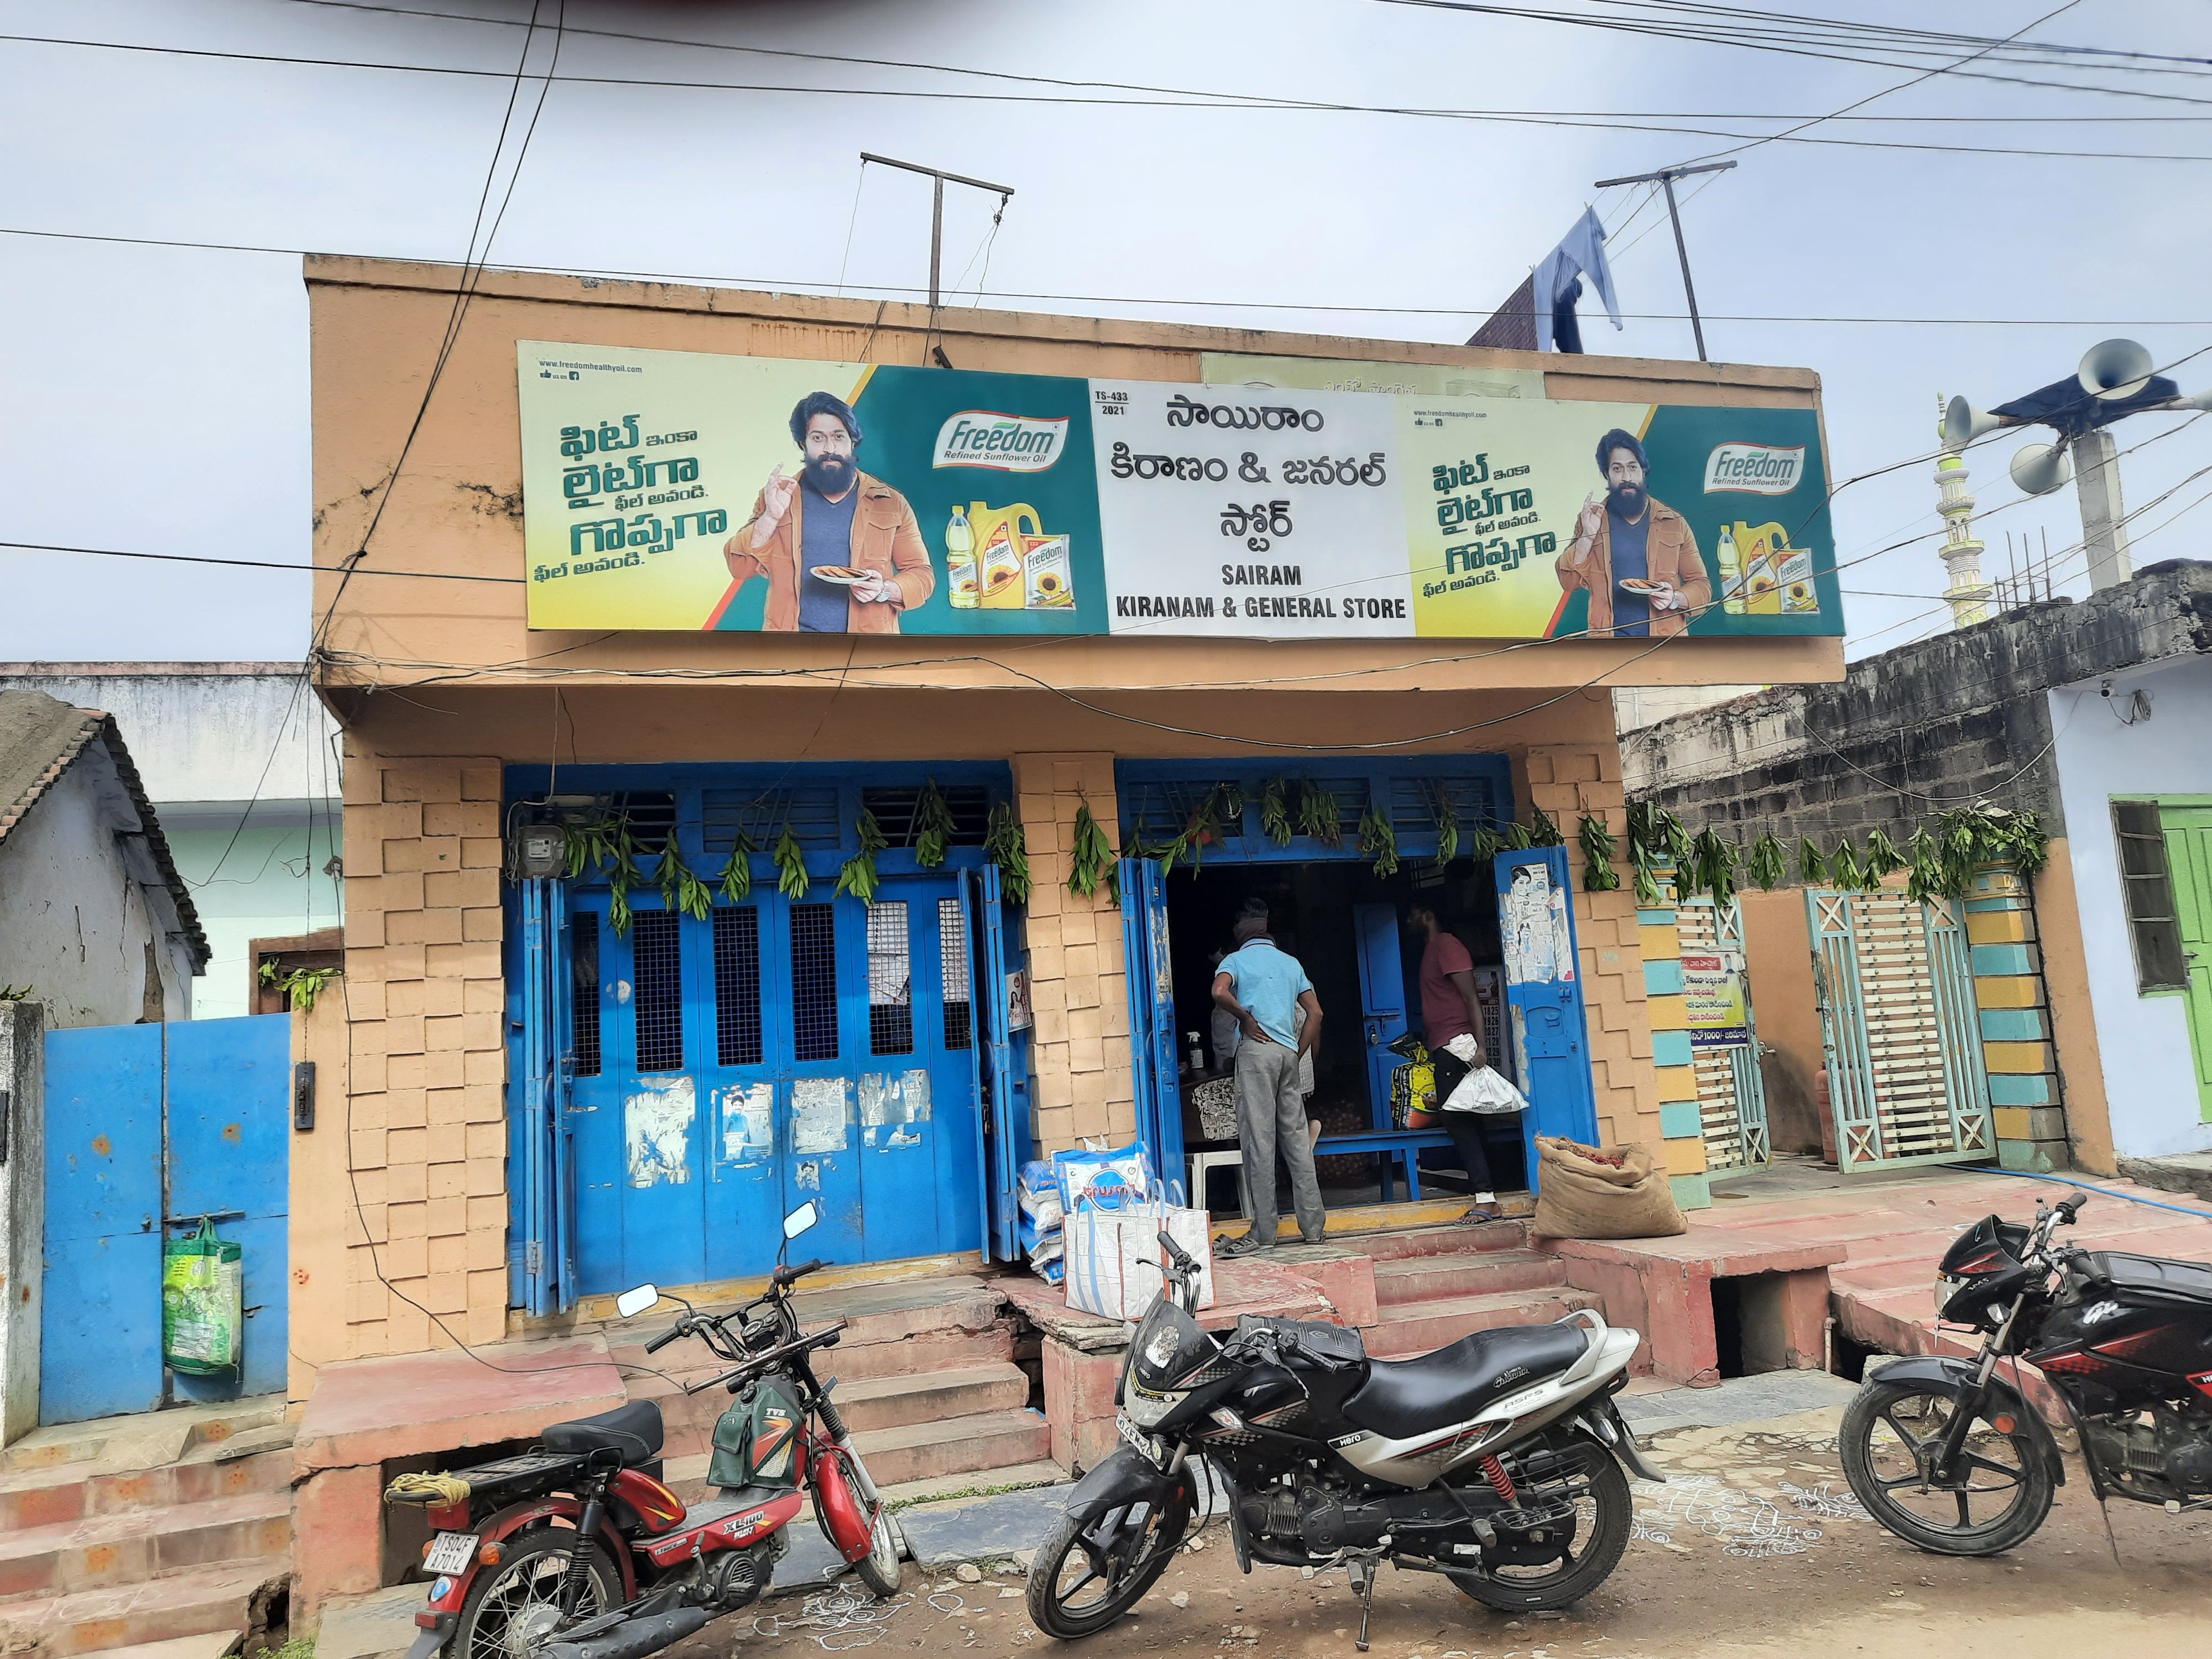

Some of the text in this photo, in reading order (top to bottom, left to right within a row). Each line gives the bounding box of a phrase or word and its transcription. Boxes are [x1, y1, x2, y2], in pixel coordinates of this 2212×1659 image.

[539, 361, 642, 373] www.freedomhealthyoil.com
[1095, 391, 1128, 401] TS-433
[1102, 405, 1124, 415] 2021
[1167, 394, 1324, 432] సాయిరాం
[560, 414, 698, 461] ఫిట్ ఇంకా
[947, 420, 1055, 453] Freedom
[944, 451, 1047, 463] Refined Sunflower Oil
[1110, 441, 1386, 486] కిరాణం & జనరల్
[1714, 451, 1796, 478] Freedom
[1432, 452, 1530, 494] ఫిట్ ఇంకా
[571, 509, 727, 556] గొప్పగా
[1220, 500, 1293, 552] స్టోర్
[1028, 545, 1062, 568] Freedom
[1446, 531, 1556, 575] గొప్పగా
[1222, 565, 1301, 586] SAIRAM
[1780, 559, 1806, 578] Freedom
[1116, 596, 1406, 618] KIRANAM & GENERAL STORE
[1484, 1006, 1499, 1015] 18 25
[1491, 1017, 1499, 1025] 26
[1491, 1027, 1499, 1036] 27
[1492, 1037, 1499, 1046] 28
[766, 1408, 786, 1416] TVS
[1339, 1434, 1361, 1447] Hero
[724, 1511, 765, 1534] XL100
[430, 1553, 463, 1572] A7014
